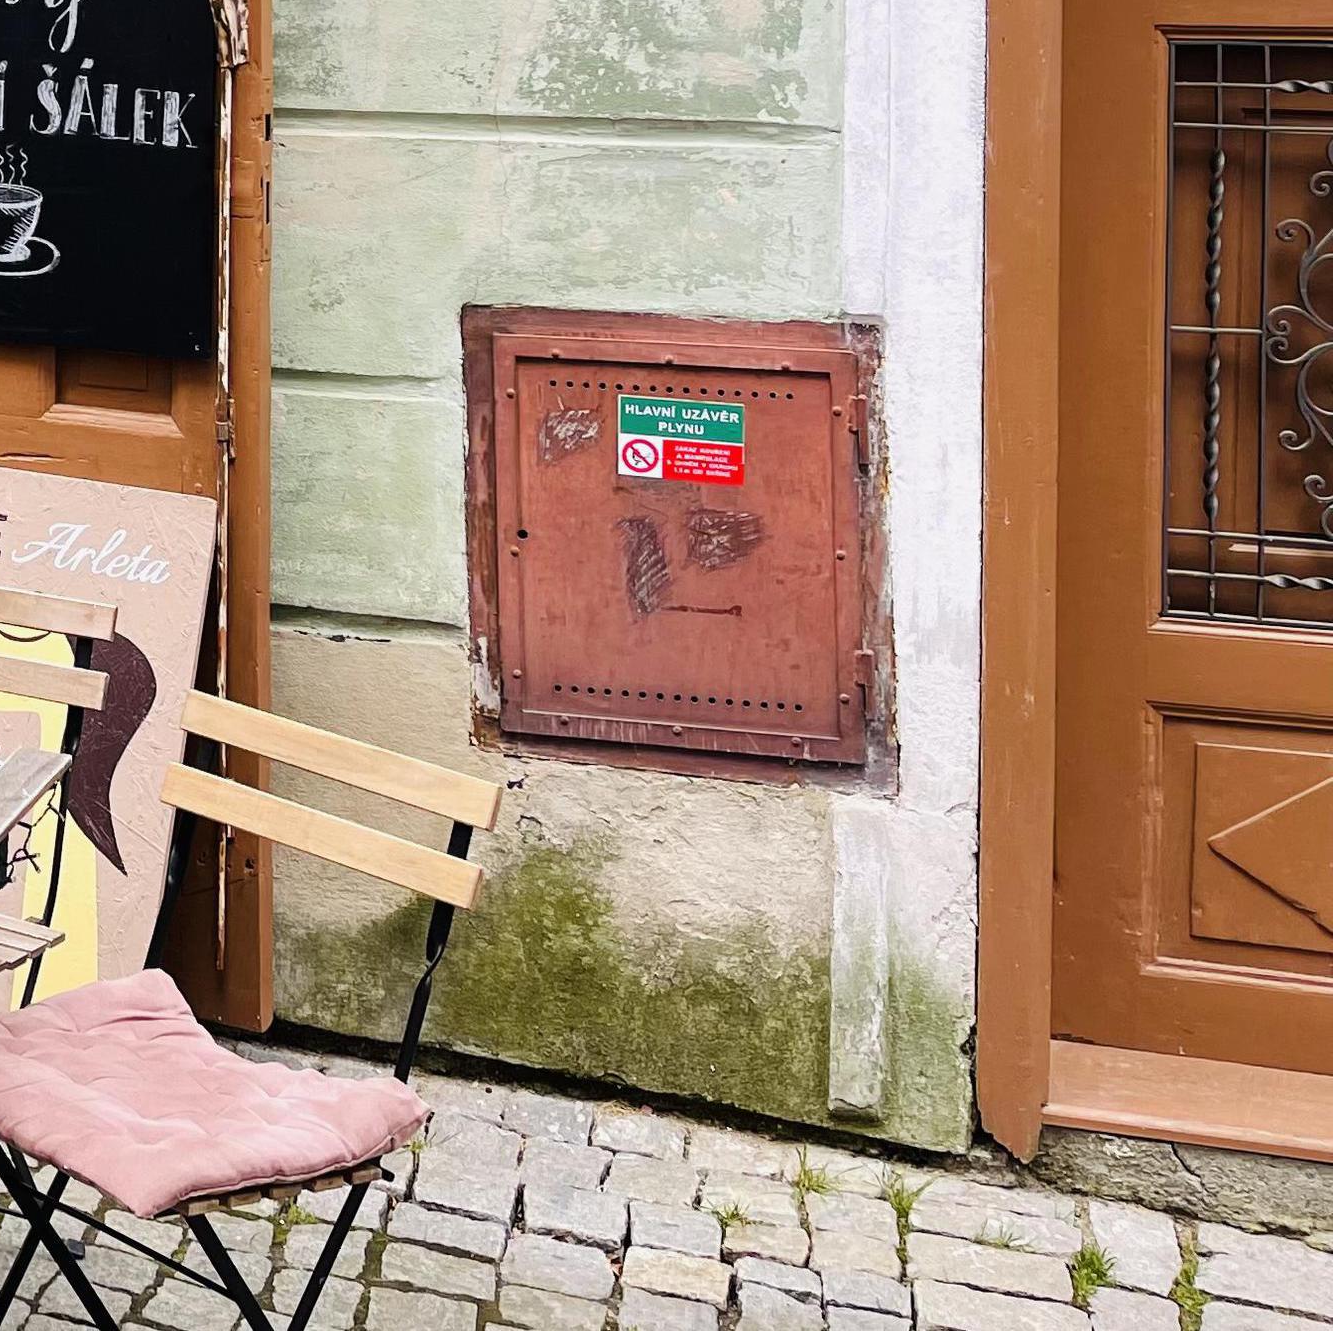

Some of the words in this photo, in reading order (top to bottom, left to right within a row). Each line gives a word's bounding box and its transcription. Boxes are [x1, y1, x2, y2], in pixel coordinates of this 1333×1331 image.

[29, 57, 199, 149] ŠÁLEK
[625, 403, 676, 418] HLAVNÍ
[681, 408, 740, 424] UZÁVĚR
[658, 421, 705, 435] PLYNU
[10, 519, 172, 586] Arleta
